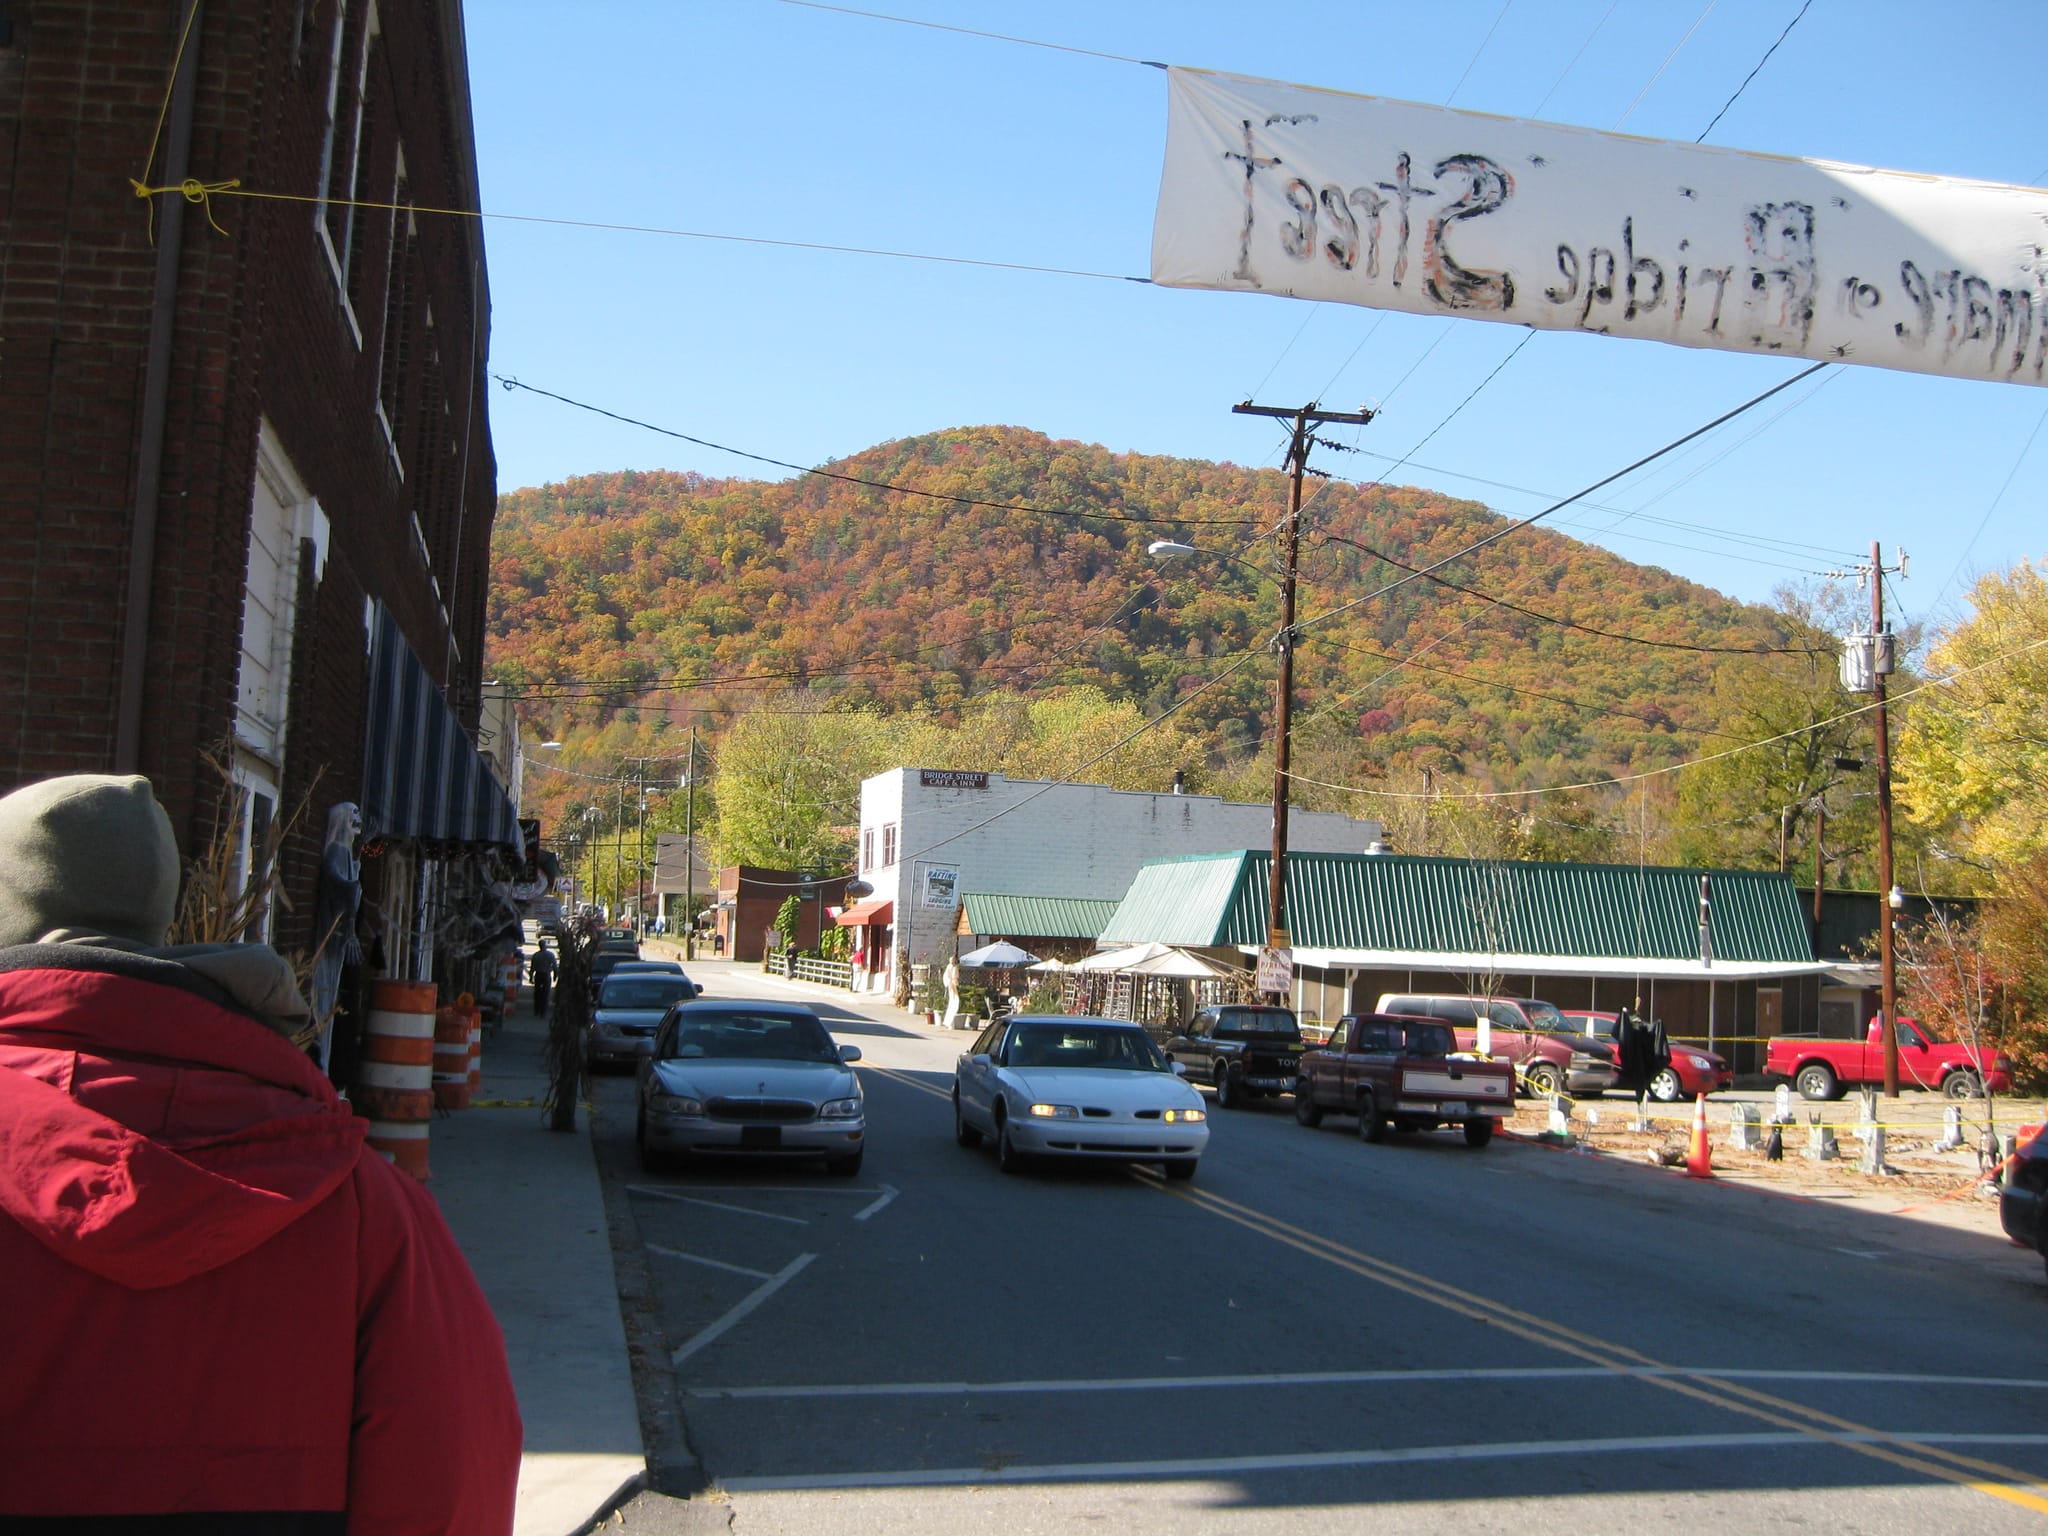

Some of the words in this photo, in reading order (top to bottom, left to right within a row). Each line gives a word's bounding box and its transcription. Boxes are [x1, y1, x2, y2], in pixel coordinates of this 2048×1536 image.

[924, 771, 954, 780] BRIDGE
[956, 773, 985, 782] STREET
[927, 870, 958, 880] RAFTING
